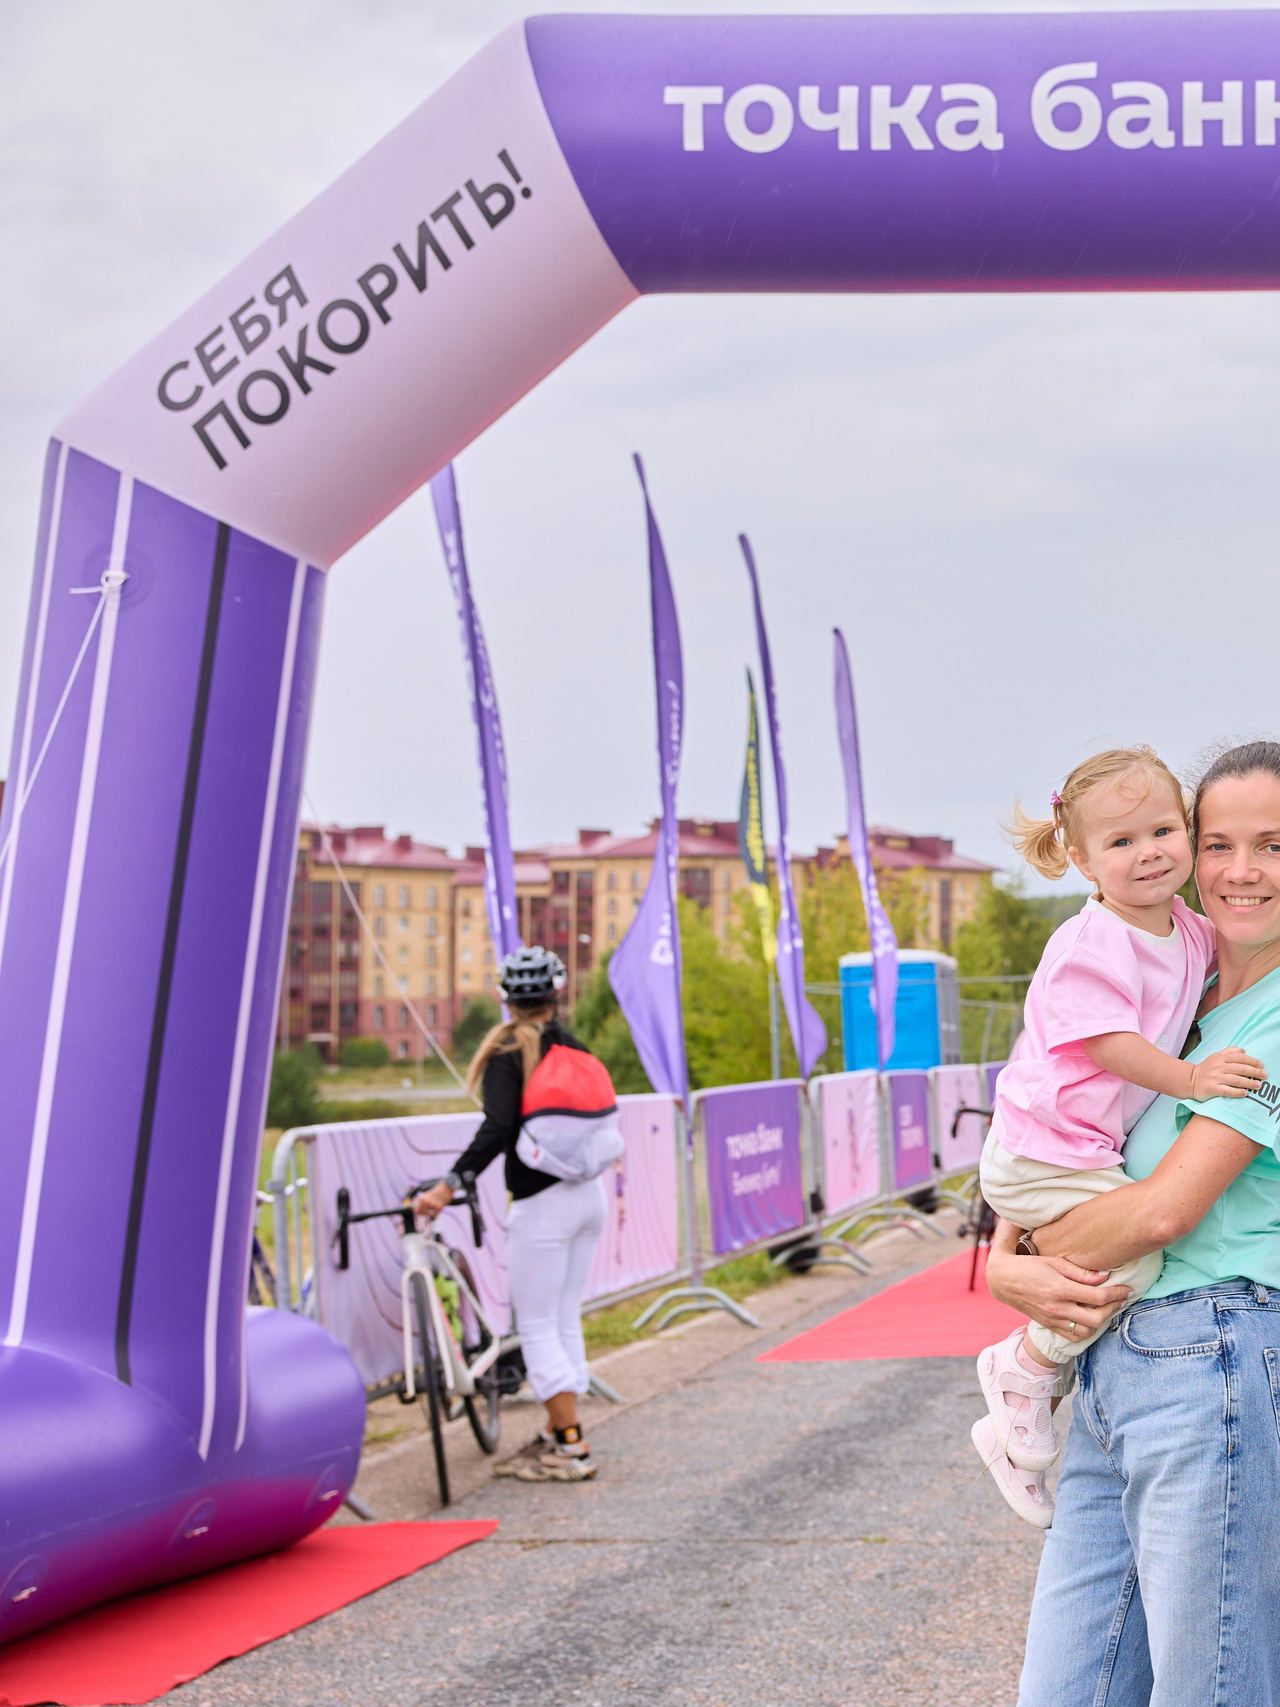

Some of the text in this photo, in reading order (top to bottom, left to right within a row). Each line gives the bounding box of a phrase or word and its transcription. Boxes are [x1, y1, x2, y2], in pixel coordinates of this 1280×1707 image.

[664, 83, 1004, 153] точка
[156, 264, 309, 412] СЕБЯ
[192, 148, 534, 470] ПОКОРИТЬ!
